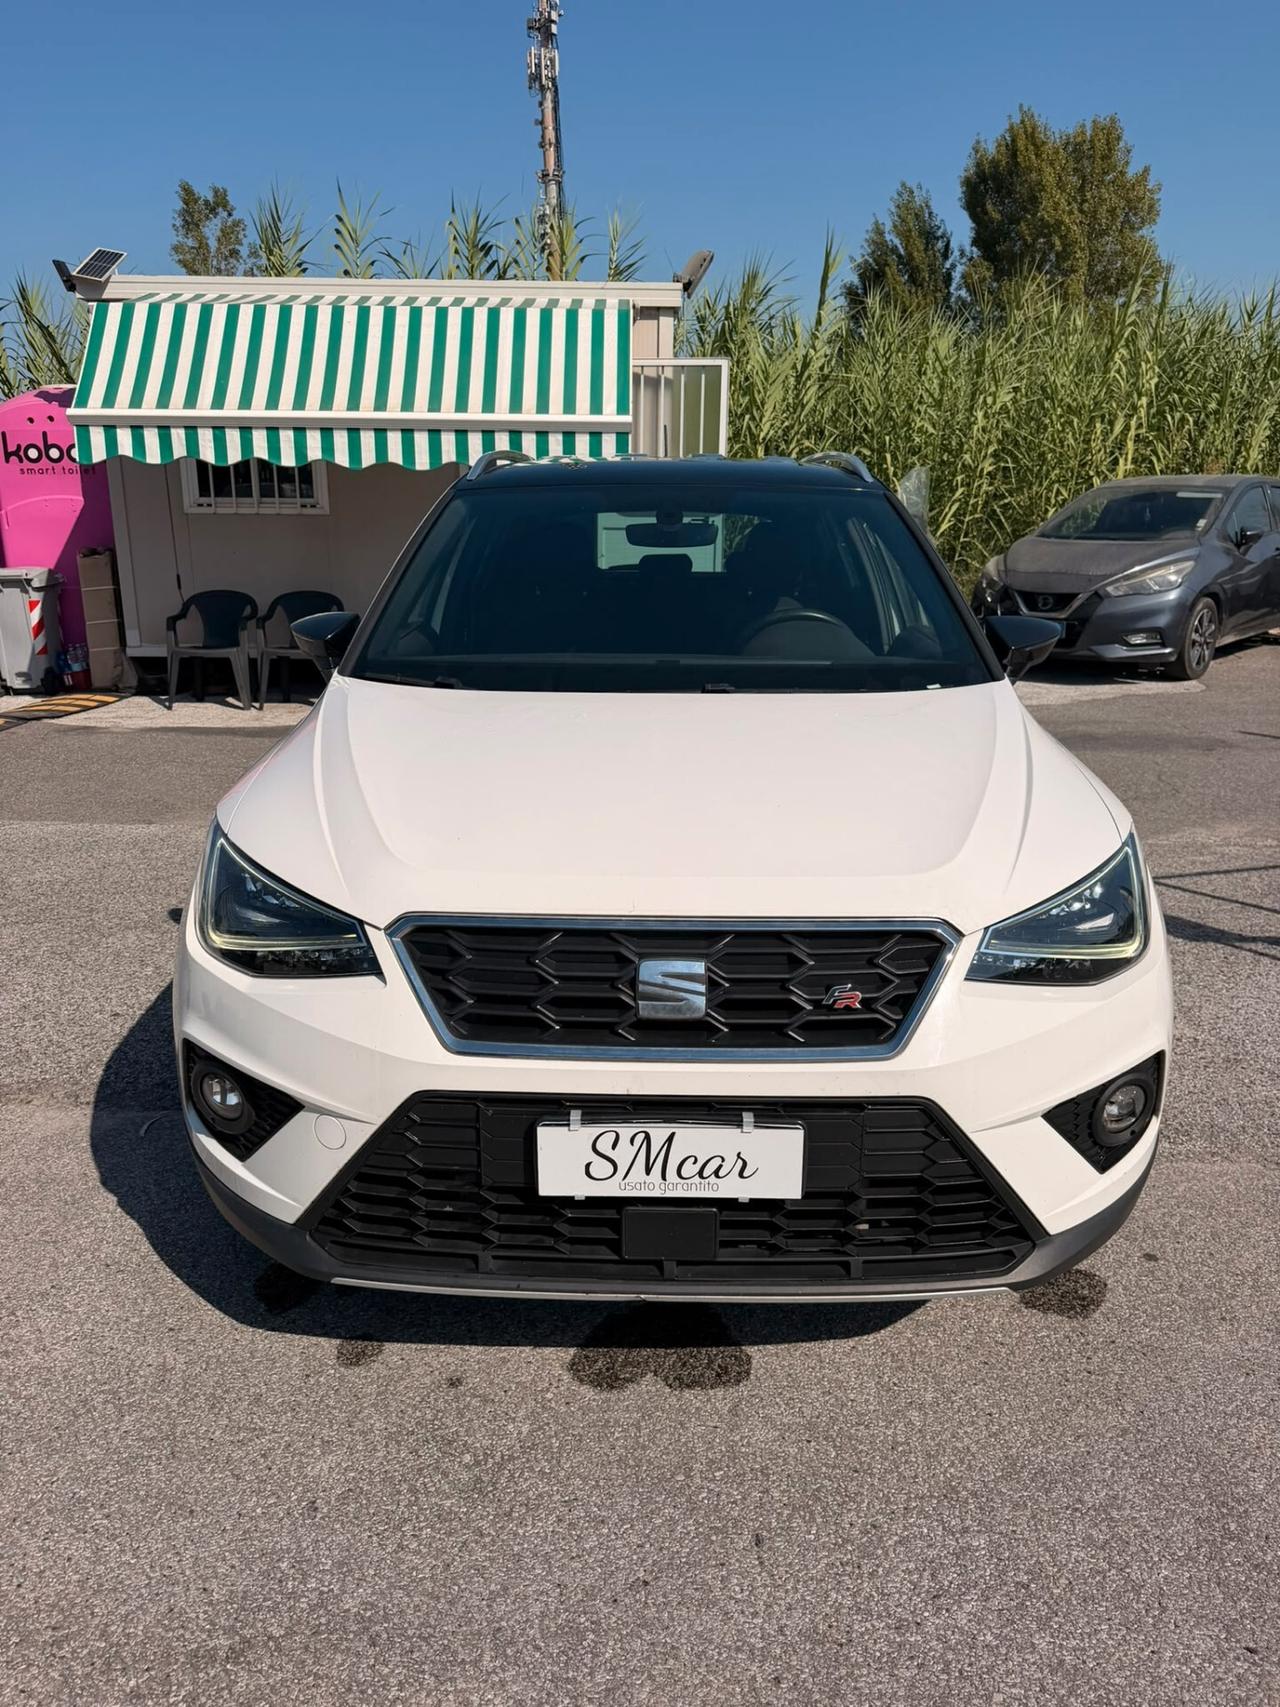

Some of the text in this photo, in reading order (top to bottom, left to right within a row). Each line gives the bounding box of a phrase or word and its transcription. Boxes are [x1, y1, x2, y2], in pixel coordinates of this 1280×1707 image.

[19, 466, 56, 475] smart
[822, 984, 862, 1009] FR
[584, 1129, 759, 1182] SMcar
[618, 1180, 720, 1195] usato garantito
